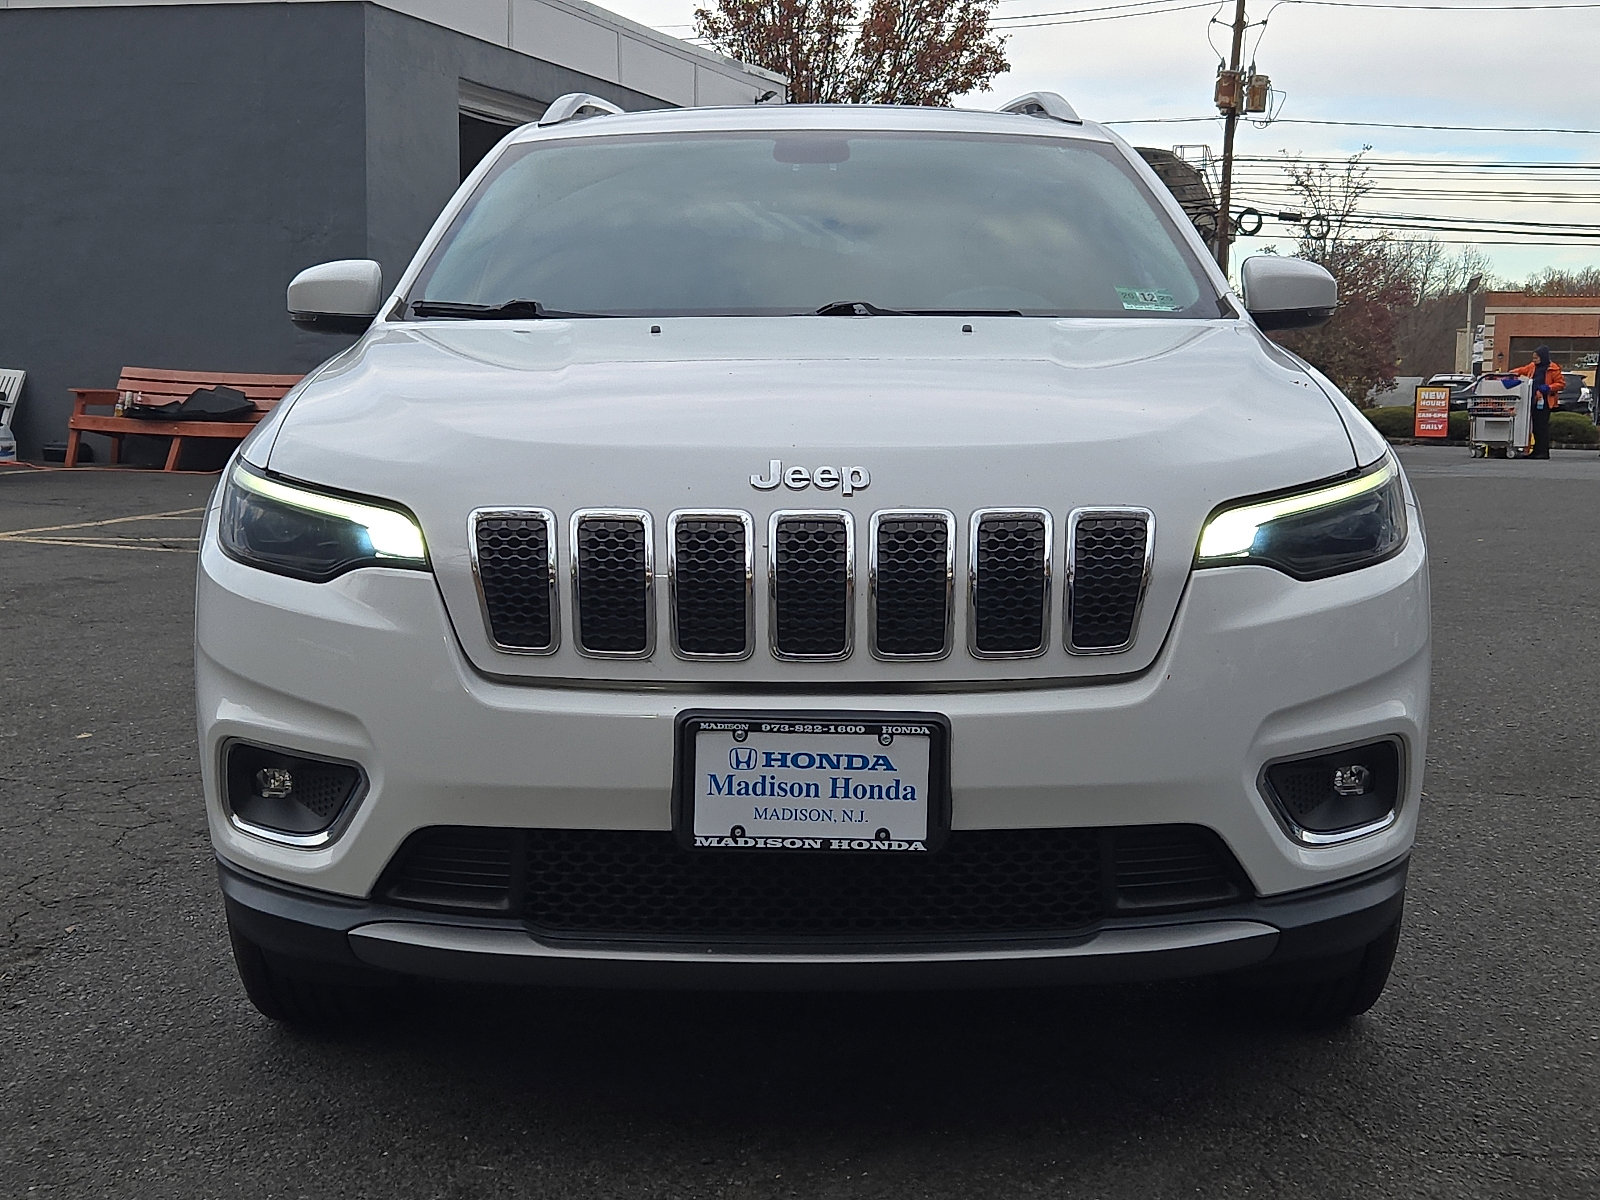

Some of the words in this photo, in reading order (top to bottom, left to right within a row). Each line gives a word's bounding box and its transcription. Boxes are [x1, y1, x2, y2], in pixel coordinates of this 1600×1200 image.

[1140, 292, 1158, 302] 12
[1420, 391, 1446, 400] NEW
[749, 459, 871, 497] Jeep
[700, 722, 749, 731] MADISON
[761, 724, 866, 734] 973-822-1600
[881, 725, 931, 735] HONDA
[761, 751, 898, 772] HONDA
[706, 773, 821, 799] Madison
[830, 777, 917, 802] Honda
[753, 807, 837, 825] MADISON,
[841, 810, 869, 823] N.J.
[693, 836, 823, 849] MADISON
[829, 838, 928, 852] HONDA
